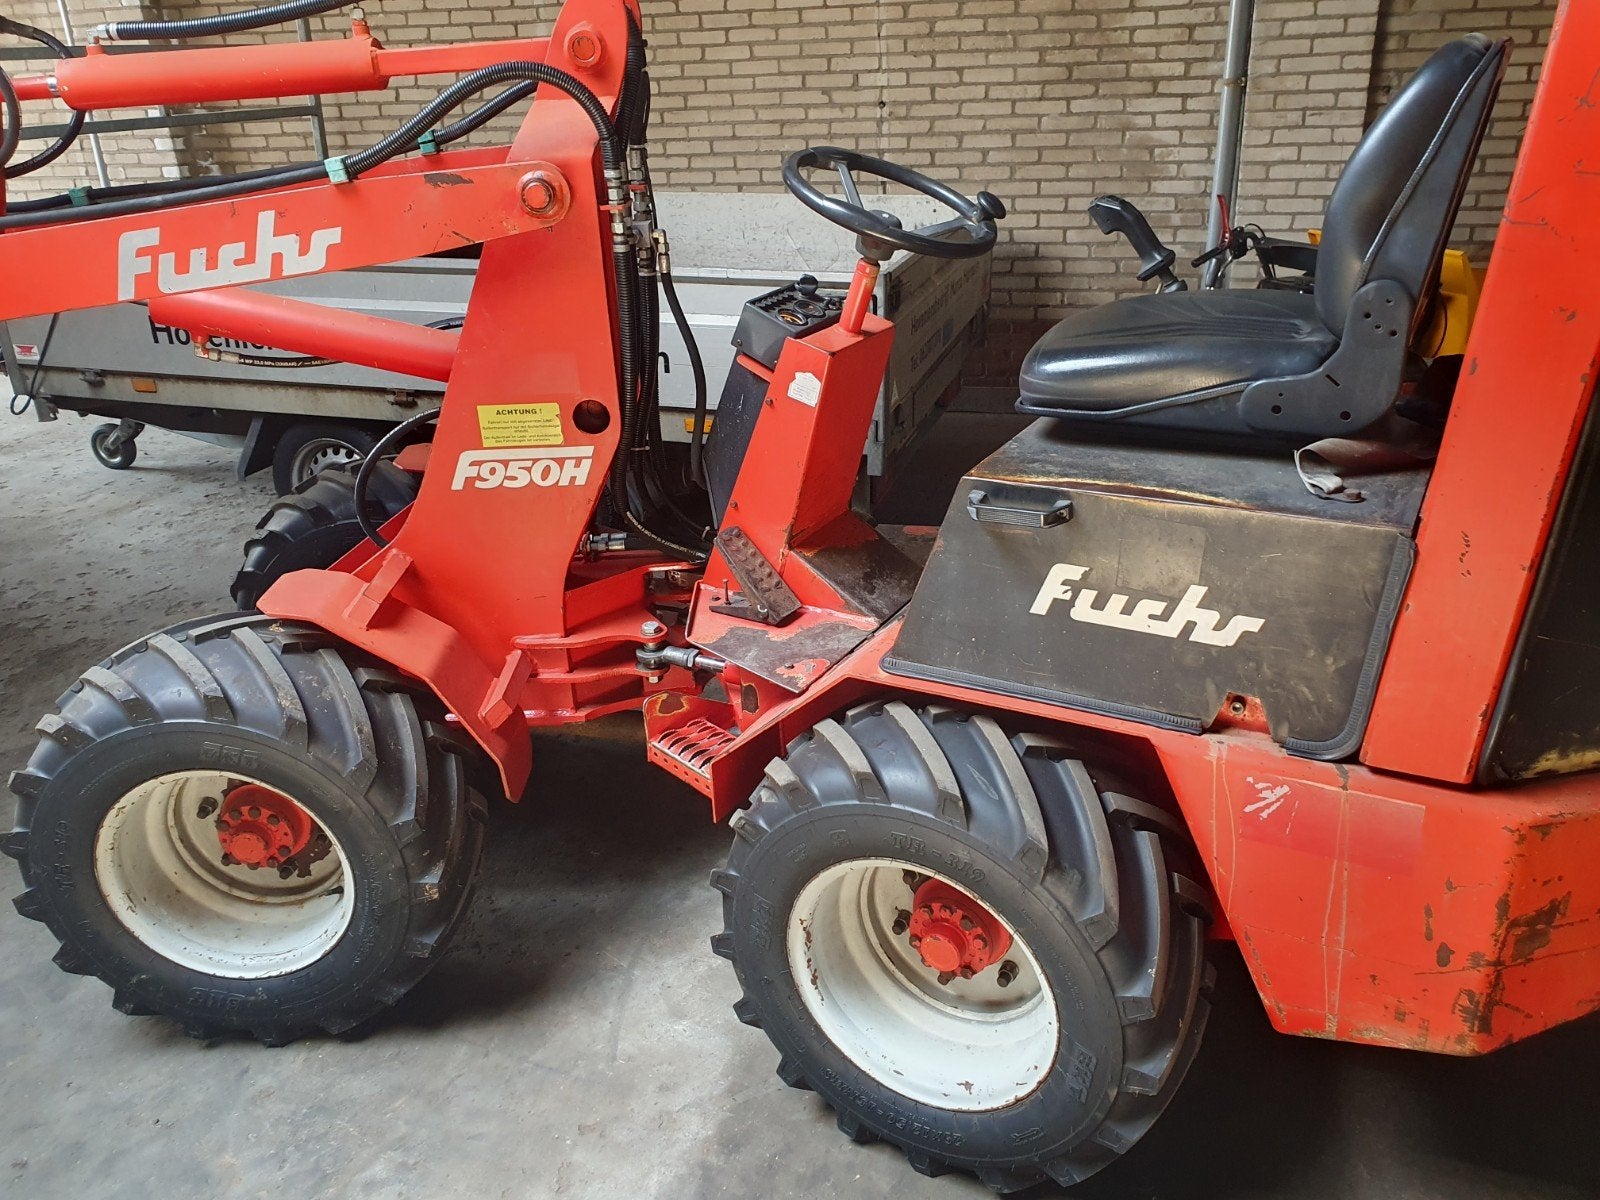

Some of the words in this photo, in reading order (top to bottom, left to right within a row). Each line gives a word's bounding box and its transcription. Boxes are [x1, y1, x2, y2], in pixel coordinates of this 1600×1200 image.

[118, 210, 342, 301] Fuchs
[496, 408, 537, 416] ACHTUNG
[451, 446, 594, 491] F950H
[1029, 563, 1266, 647] Fuchs
